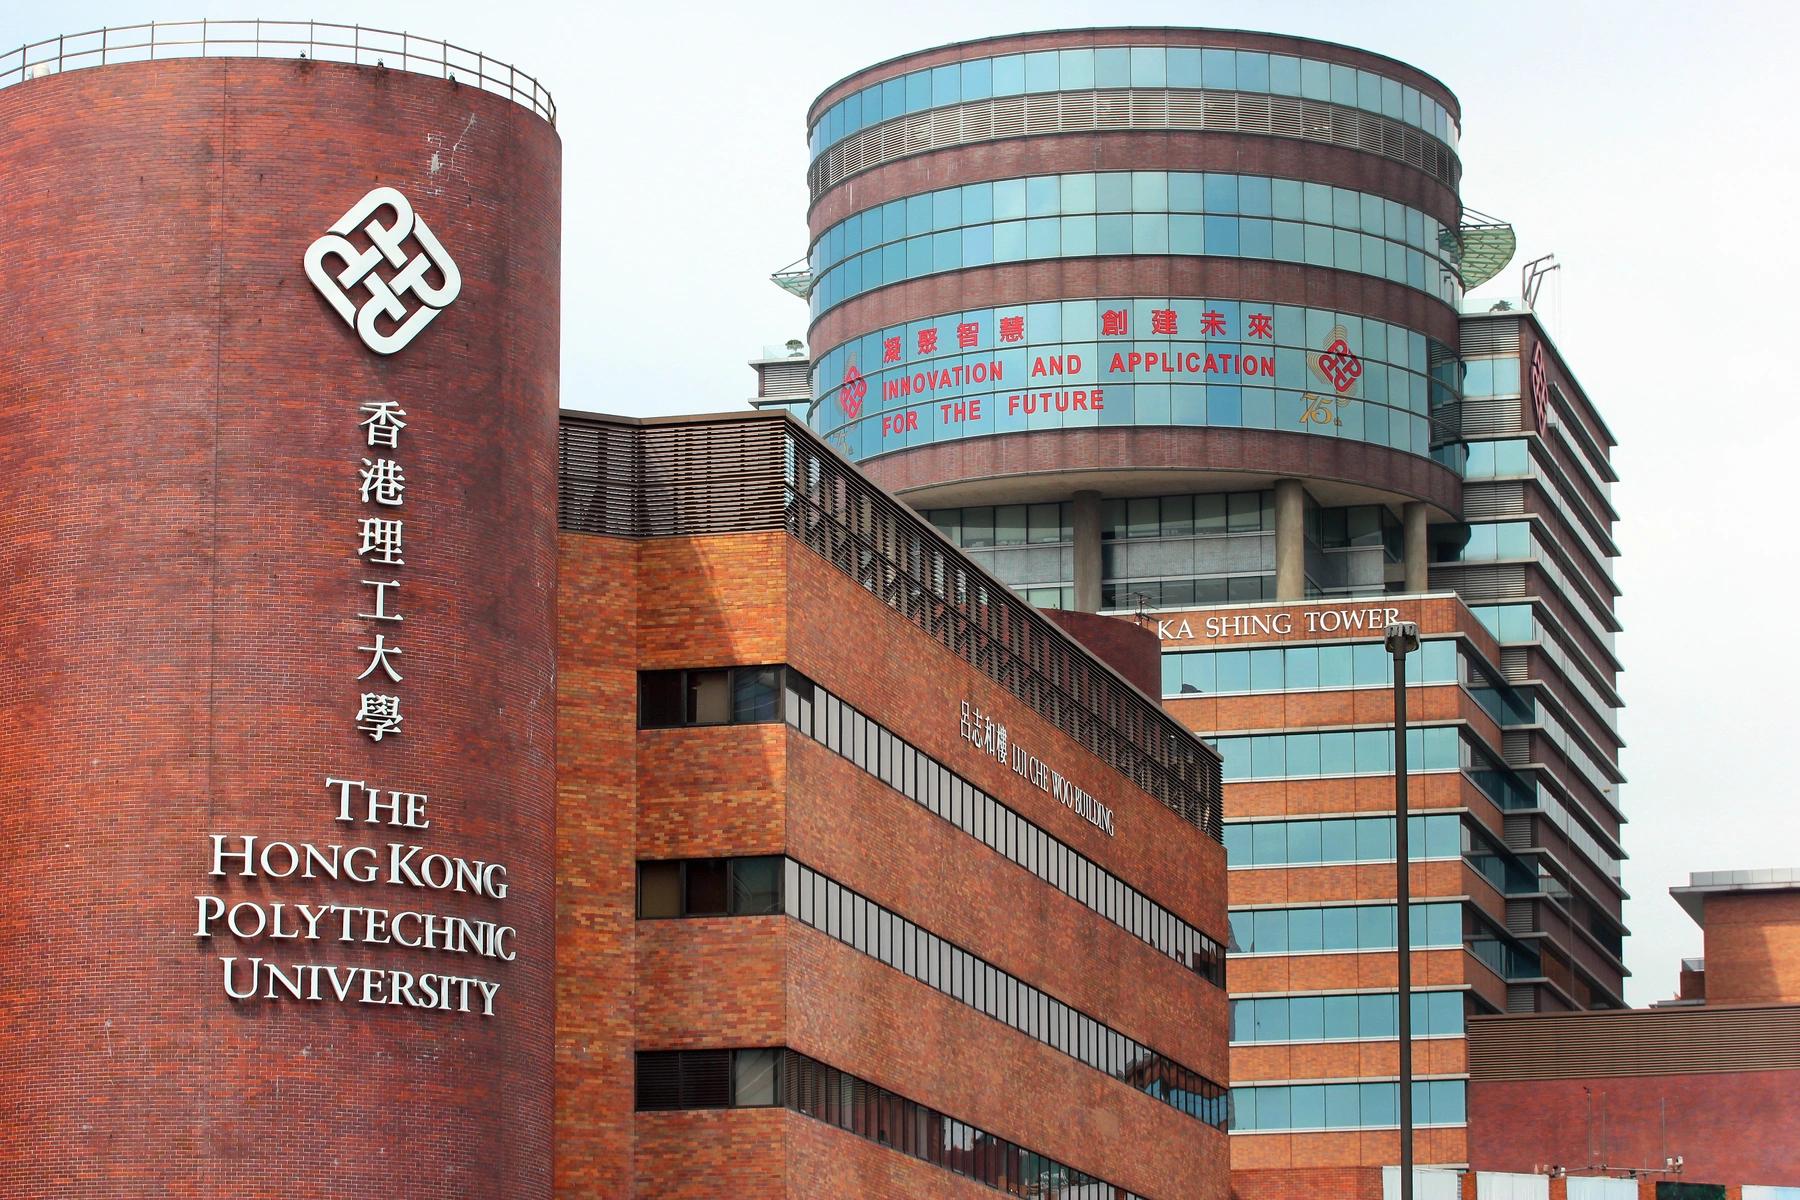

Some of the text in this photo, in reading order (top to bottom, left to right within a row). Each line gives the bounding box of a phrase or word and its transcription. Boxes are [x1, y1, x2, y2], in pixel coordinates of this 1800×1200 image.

[883, 309, 1273, 364] 凝聚智慧 創建未來
[883, 352, 1275, 401] INNOVATION AND APPLICATION
[882, 389, 1104, 437] FOR THE FUTURE
[355, 400, 408, 742] 香港理工大學
[1158, 608, 1399, 640] KA SHING TOWER
[960, 699, 1115, 837] 呂志和樓 LUI CHE WOO BUILDING
[325, 777, 430, 829] THE
[208, 834, 508, 899] HONG KONG
[193, 895, 517, 961] POLYTECHNIC
[219, 956, 501, 1016] UNIVERSITY
